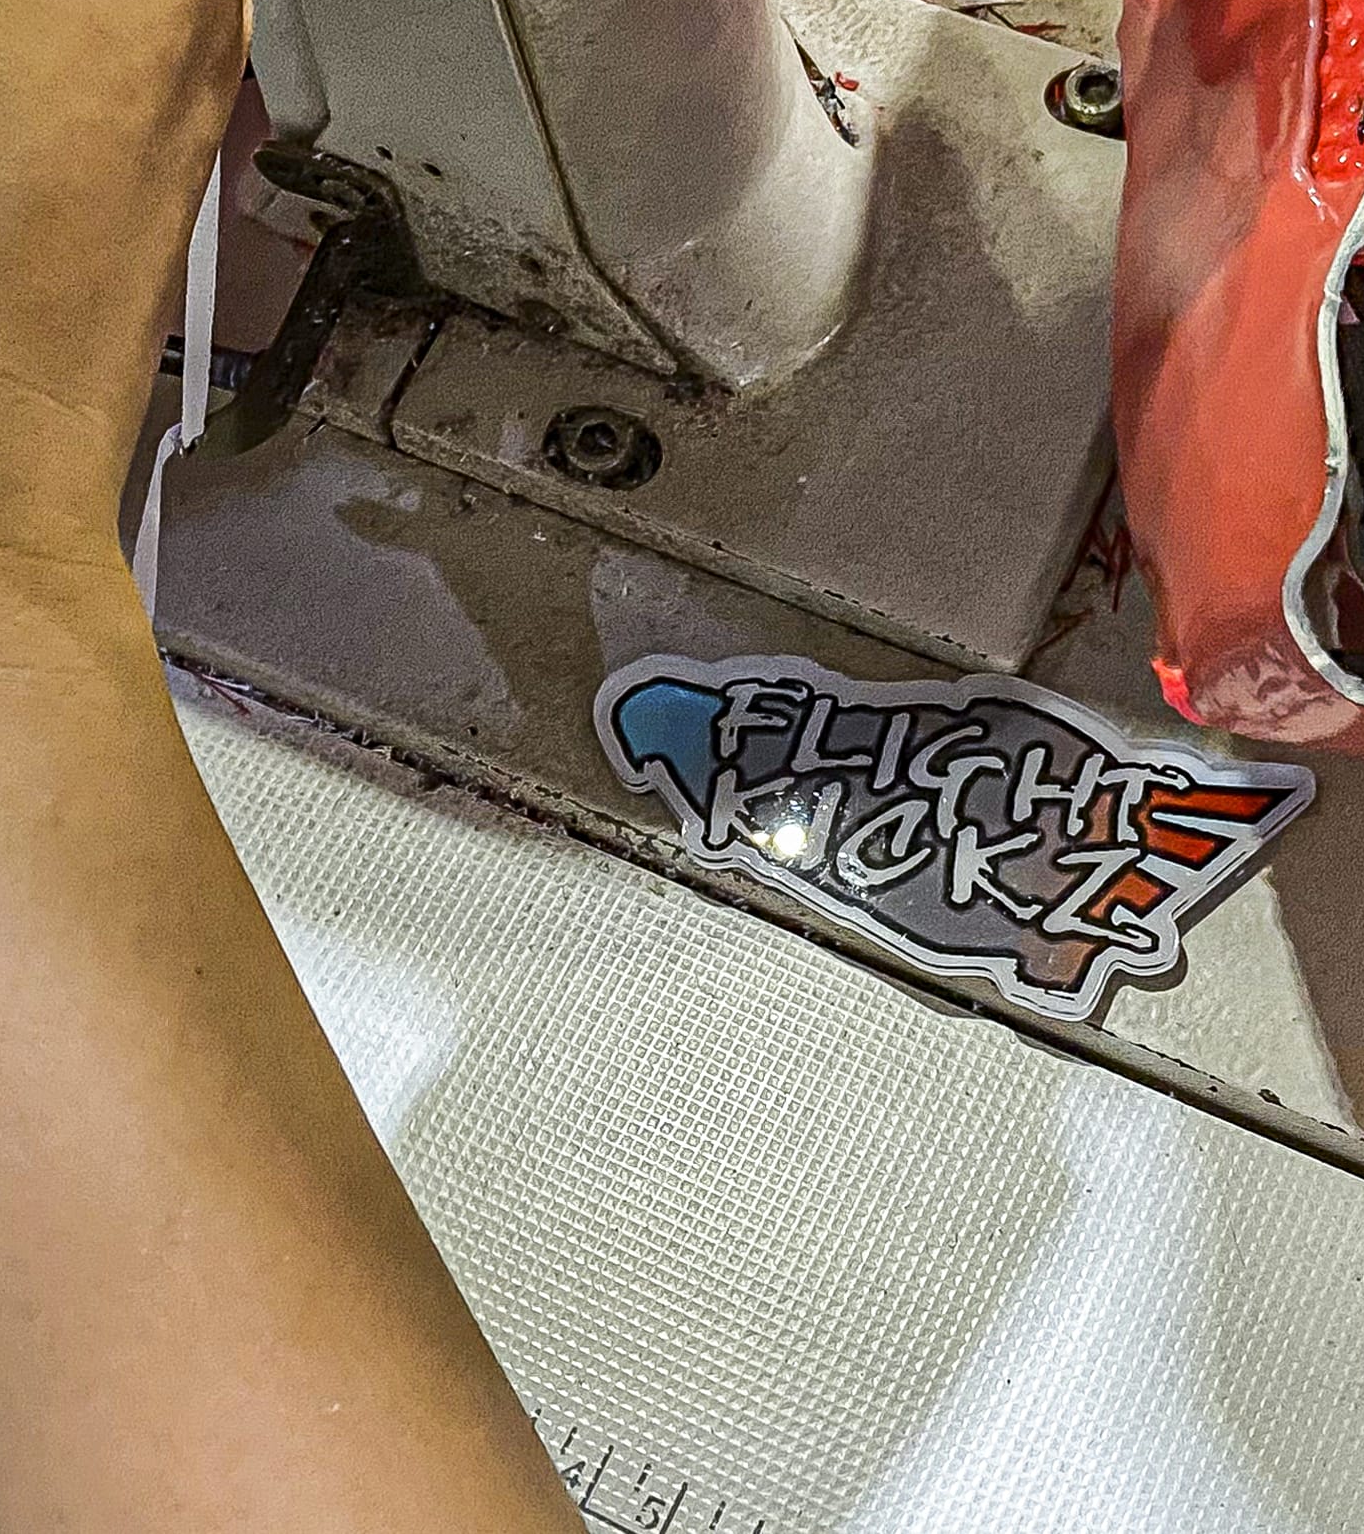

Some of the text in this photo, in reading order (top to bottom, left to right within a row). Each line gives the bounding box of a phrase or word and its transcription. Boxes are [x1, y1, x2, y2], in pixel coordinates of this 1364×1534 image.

[717, 682, 1191, 843] FLIGHT
[707, 769, 1155, 950] KICKZ
[635, 1494, 667, 1530] 5
